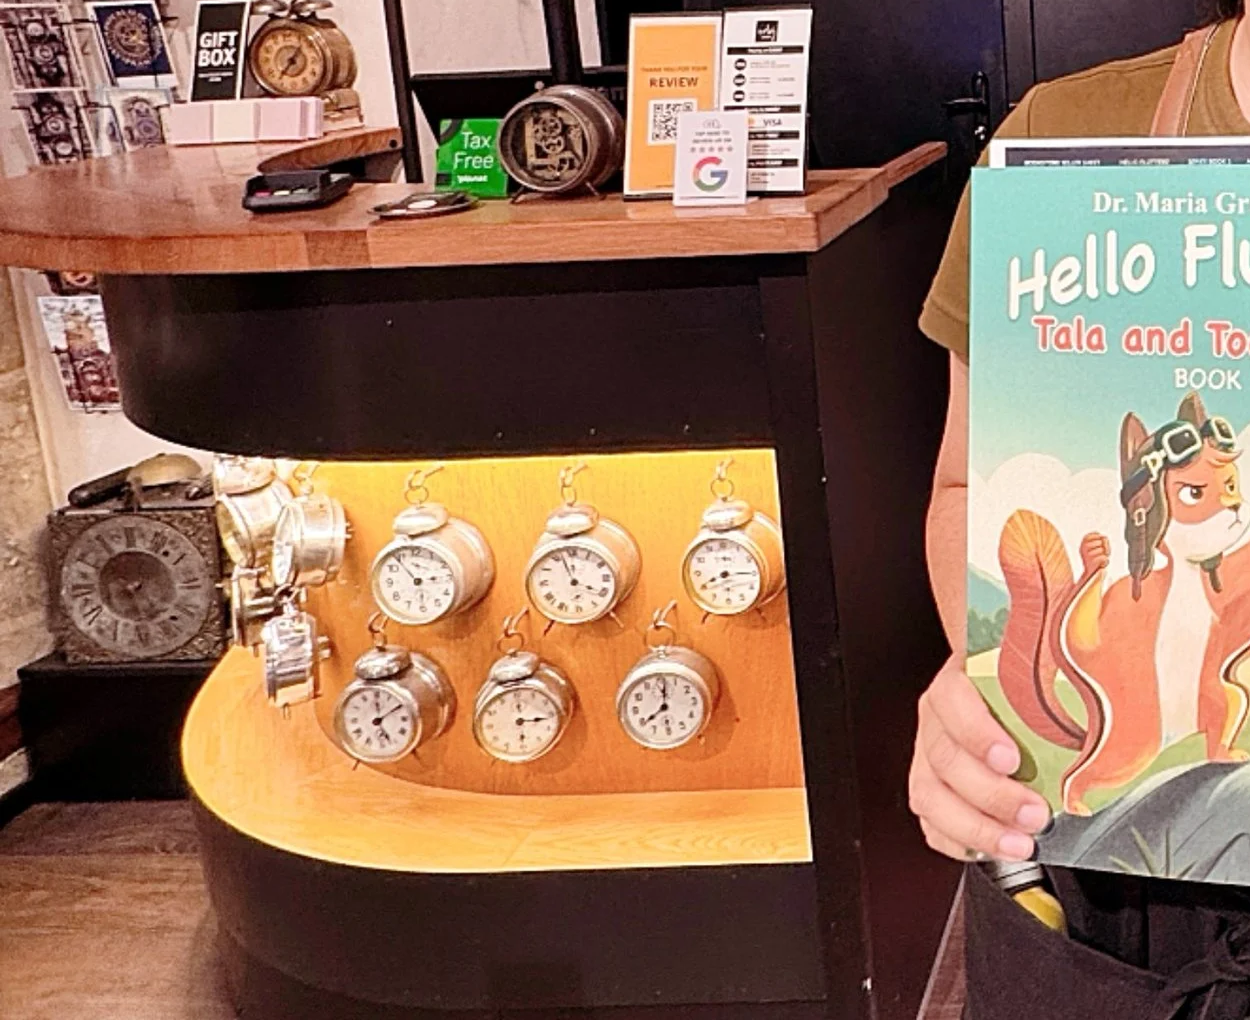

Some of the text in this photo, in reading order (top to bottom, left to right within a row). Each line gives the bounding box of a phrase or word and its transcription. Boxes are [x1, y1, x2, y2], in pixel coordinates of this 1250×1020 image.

[199, 31, 238, 48] GIFT
[198, 48, 236, 67] BOX
[649, 76, 699, 88] REVIEW
[763, 119, 783, 127] VISA
[462, 131, 492, 150] Tax
[453, 152, 494, 170] Free
[1092, 191, 1128, 214] Dr.
[1135, 190, 1208, 214] Maria
[1008, 229, 1156, 321] Hello
[1032, 316, 1107, 354] Tala
[1122, 320, 1193, 357] and
[1174, 368, 1242, 390] BOOK
